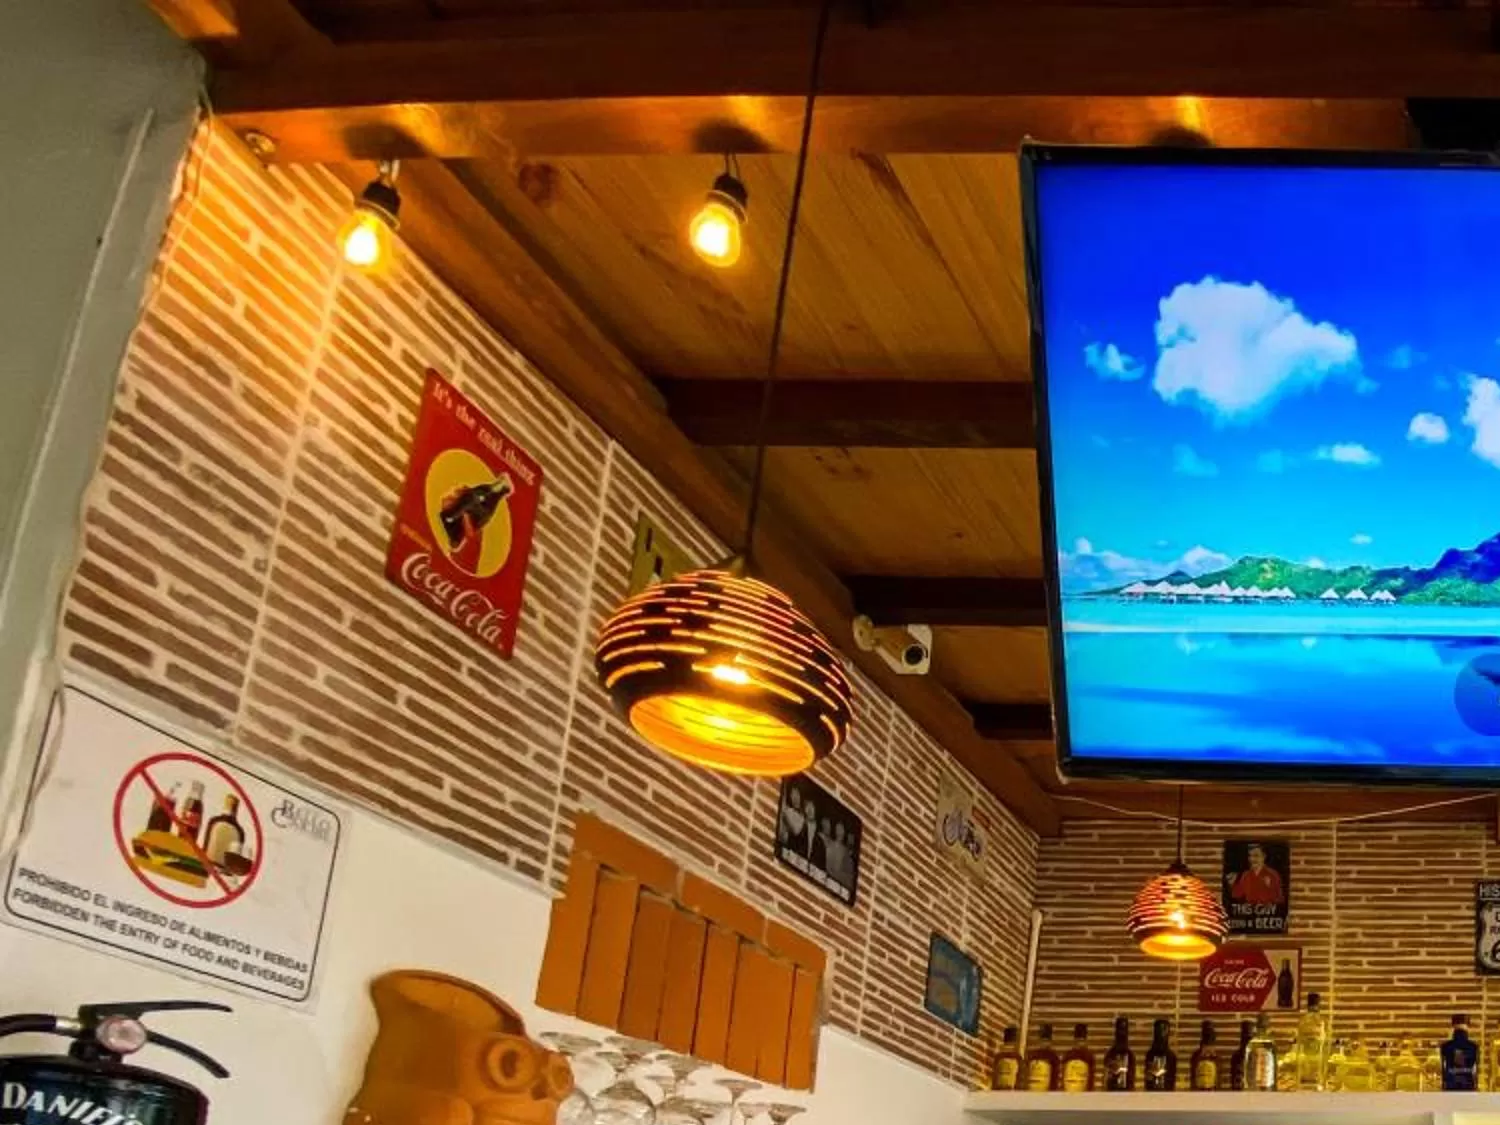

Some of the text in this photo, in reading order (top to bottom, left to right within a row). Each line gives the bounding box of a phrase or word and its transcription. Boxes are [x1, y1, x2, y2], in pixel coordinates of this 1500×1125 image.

[401, 552, 507, 644] Coca-Cola
[13, 887, 305, 990] FORBIDDEN THE ENTRY OF FOOD AND BEVERAGES
[19, 867, 91, 901] PROHIBIDO
[93, 892, 110, 908] EL
[112, 900, 168, 927] INGRESO
[169, 919, 187, 934] DE
[188, 926, 252, 954] ALIMENTOS
[263, 950, 308, 973] BEBIDAS
[1204, 967, 1269, 989] Coca-Cola
